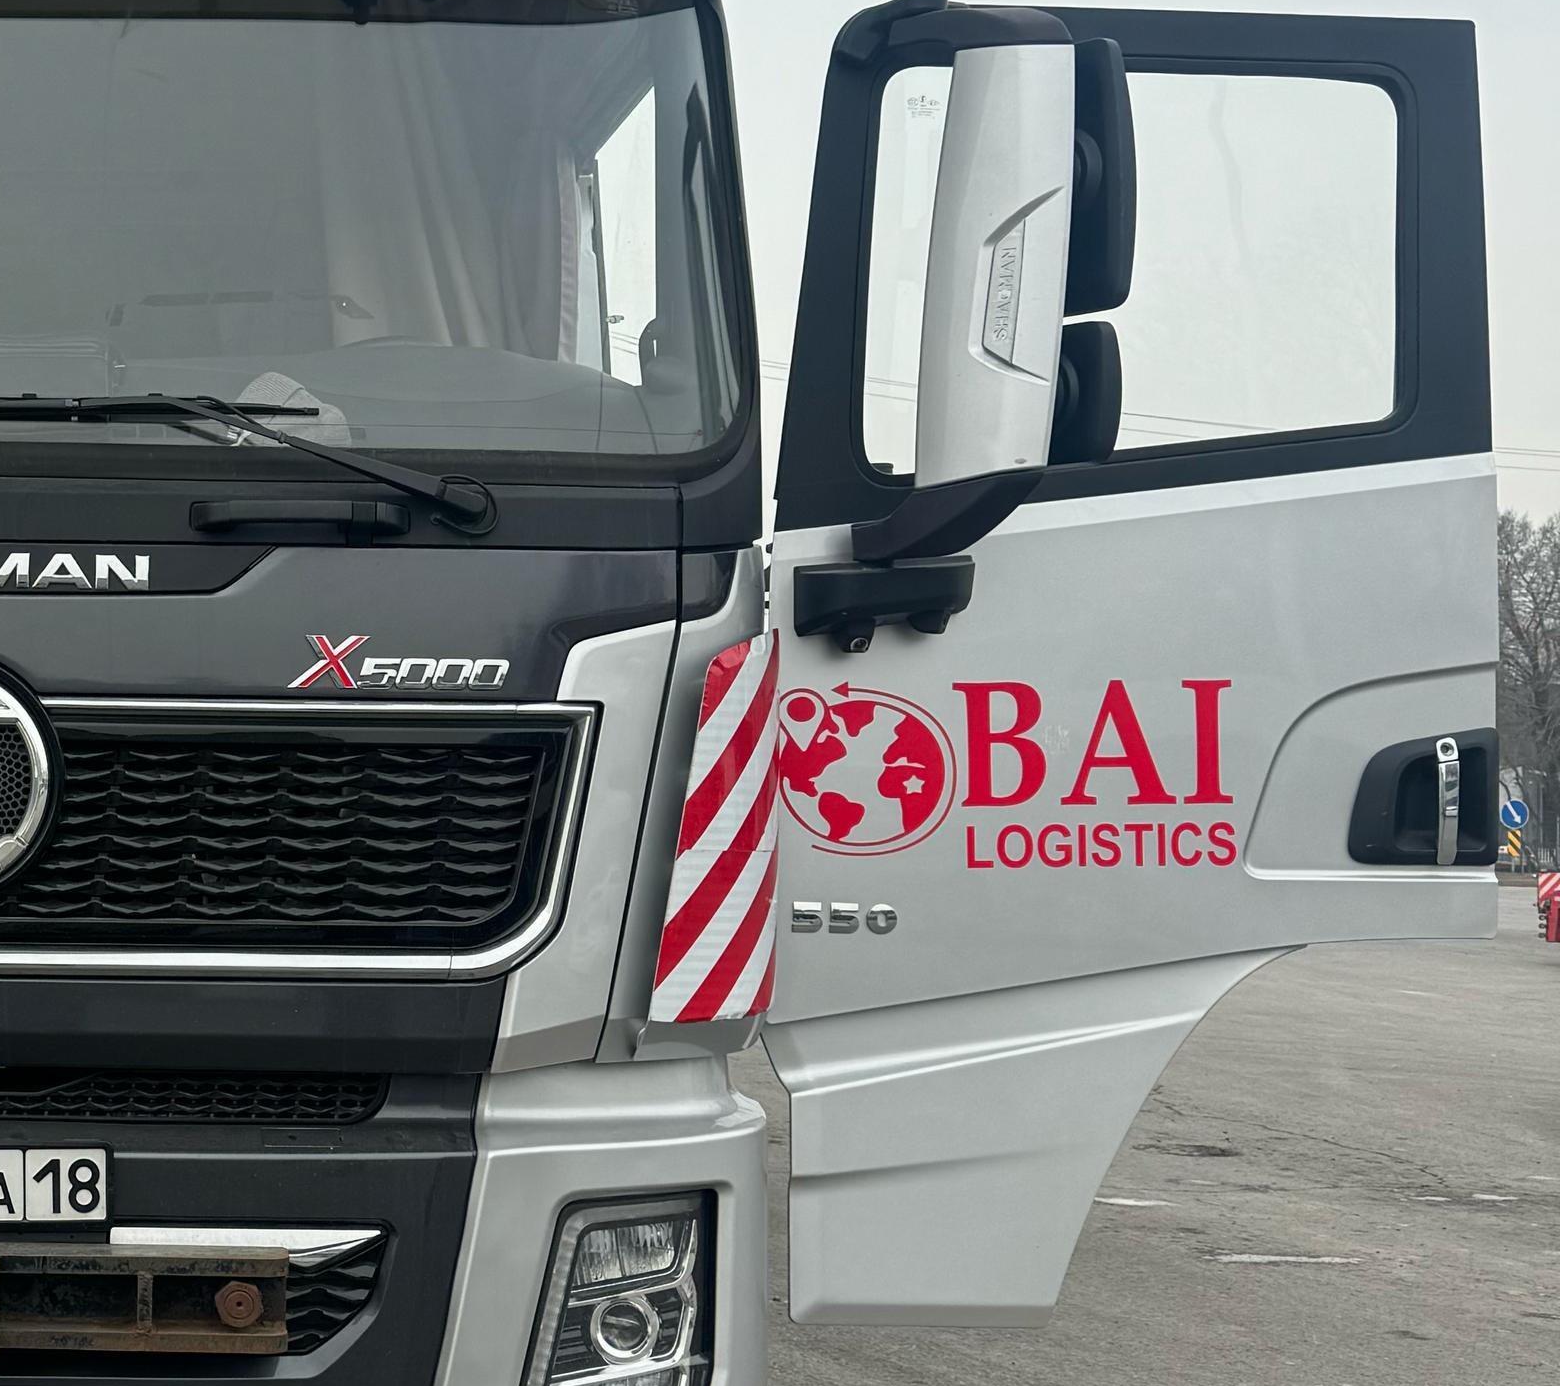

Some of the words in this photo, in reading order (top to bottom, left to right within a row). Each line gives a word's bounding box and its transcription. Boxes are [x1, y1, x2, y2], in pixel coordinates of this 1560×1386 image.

[287, 634, 510, 690] X5000
[952, 679, 1234, 809] BAI
[966, 821, 1238, 869] LOGISTICS
[791, 901, 898, 935] 550
[32, 1158, 101, 1214] 18
